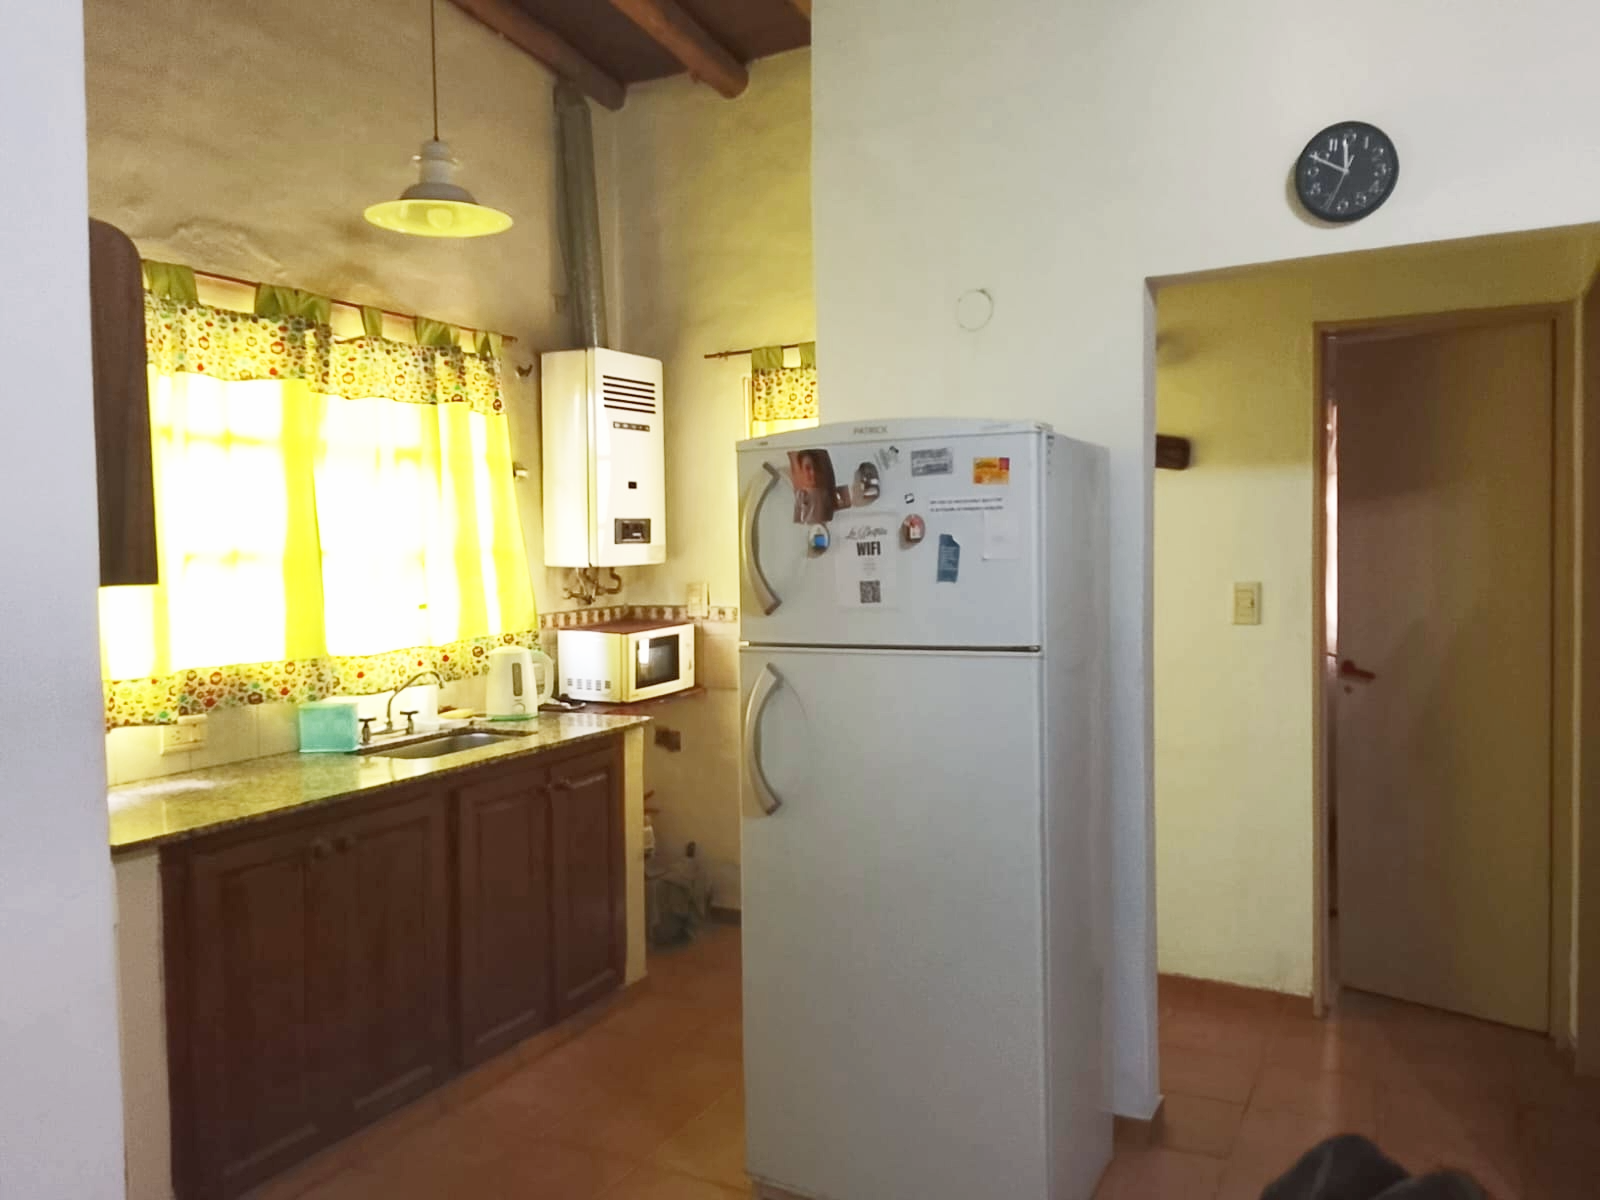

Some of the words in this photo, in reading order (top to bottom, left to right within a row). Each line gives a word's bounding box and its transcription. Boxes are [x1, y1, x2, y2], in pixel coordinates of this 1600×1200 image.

[1328, 138, 1338, 152] 11
[1364, 135, 1369, 150] 1
[856, 540, 882, 556] WIFI
